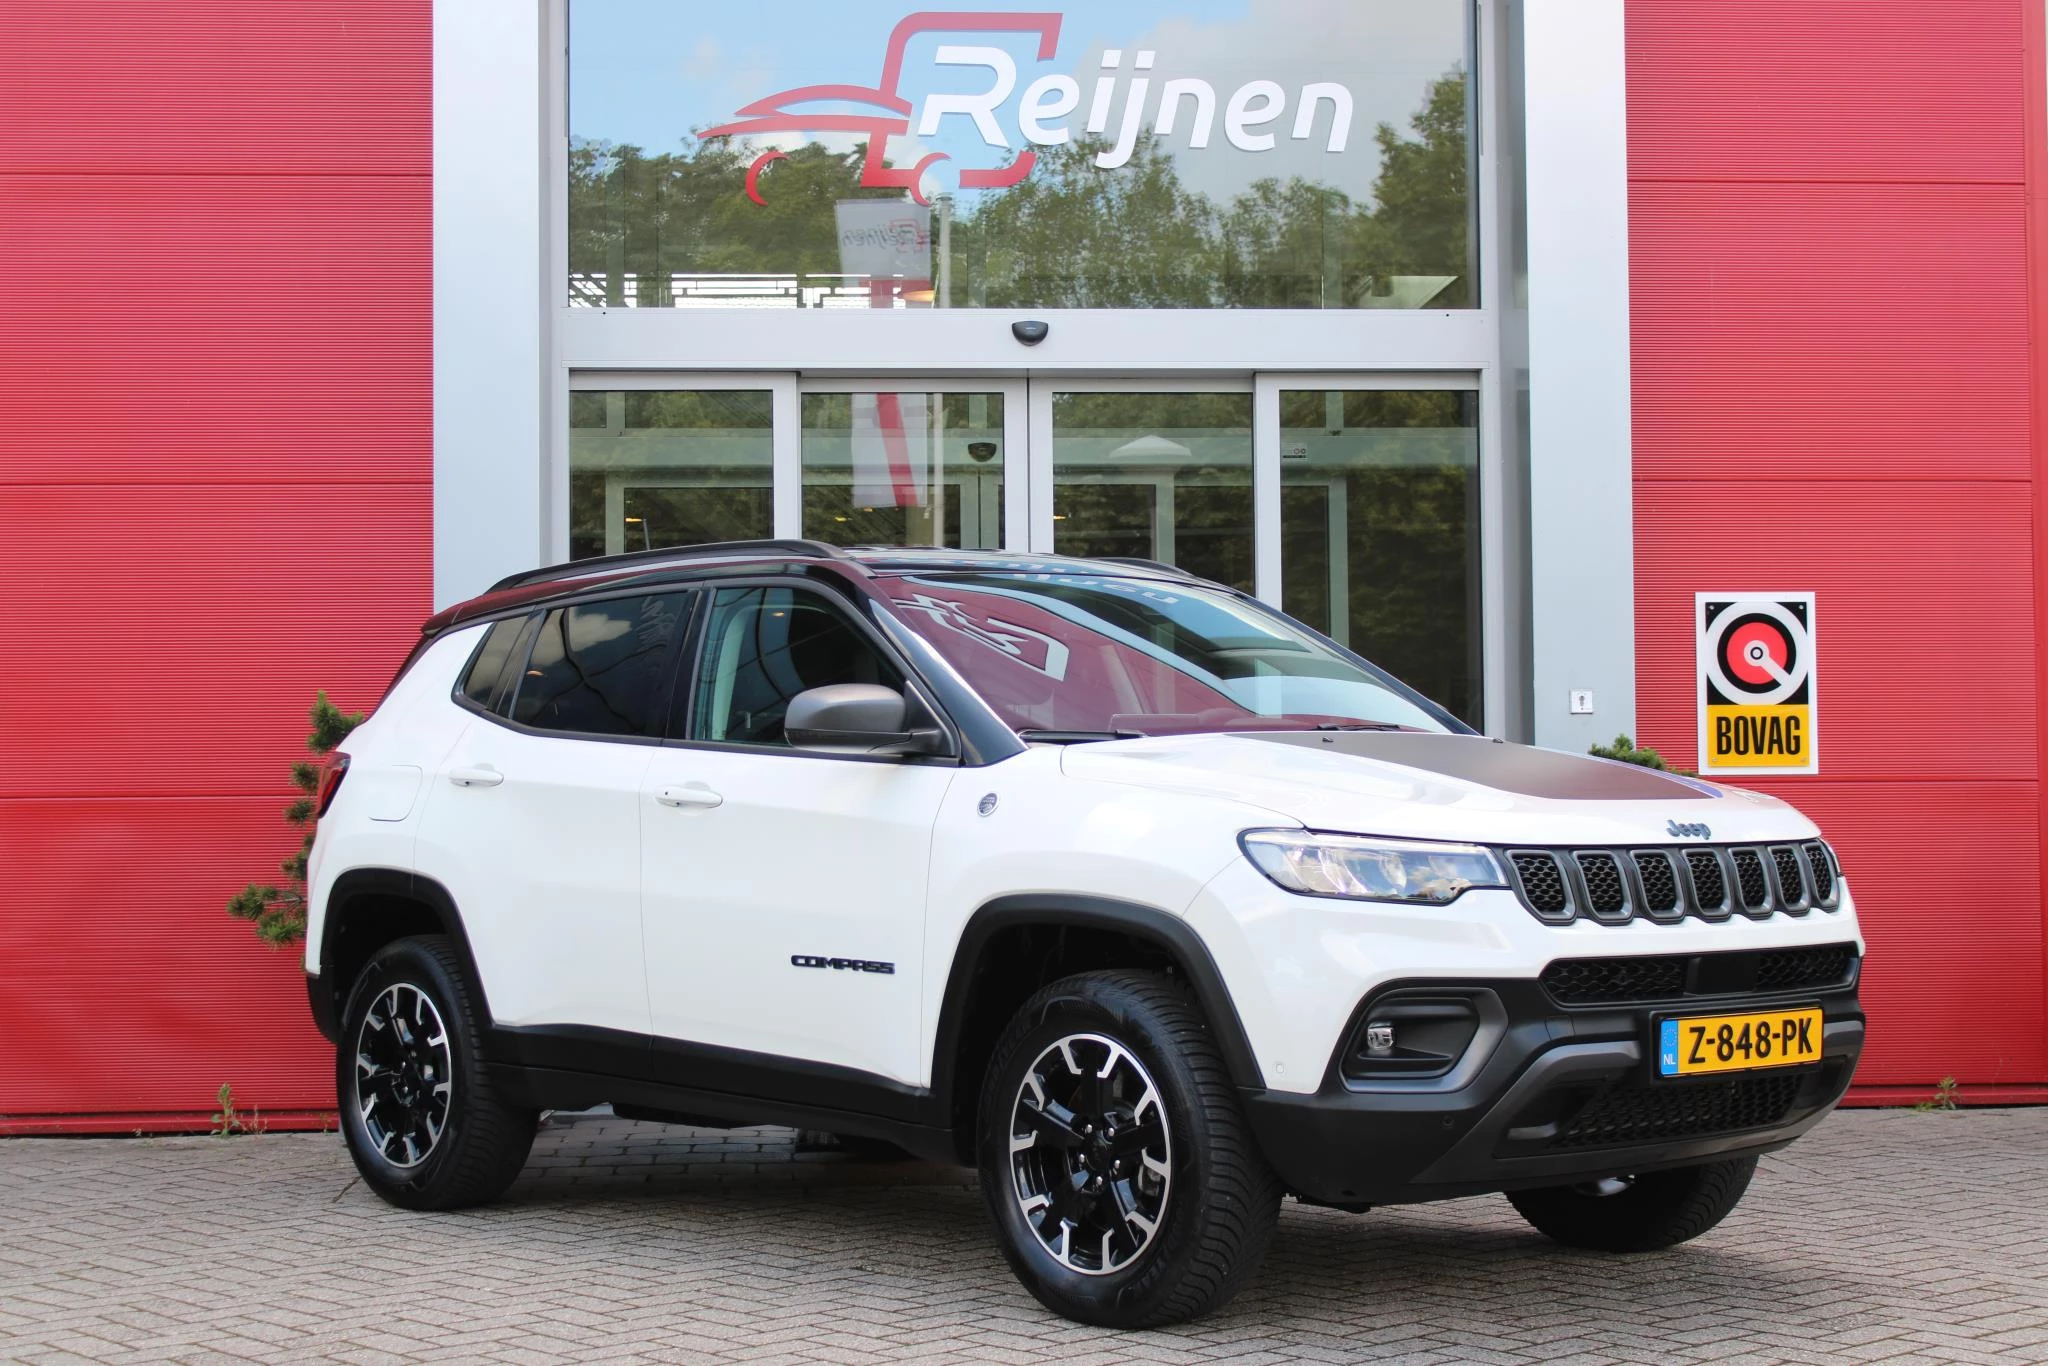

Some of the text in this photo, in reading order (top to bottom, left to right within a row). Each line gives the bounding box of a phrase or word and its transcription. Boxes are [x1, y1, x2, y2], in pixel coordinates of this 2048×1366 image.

[918, 45, 1354, 169] Reijnen
[1716, 715, 1801, 755] BOVAG
[1666, 819, 1711, 841] Jeep
[791, 955, 895, 975] COMPASS
[1688, 1017, 1813, 1065] Z-848-PK
[1663, 1053, 1676, 1065] NL
